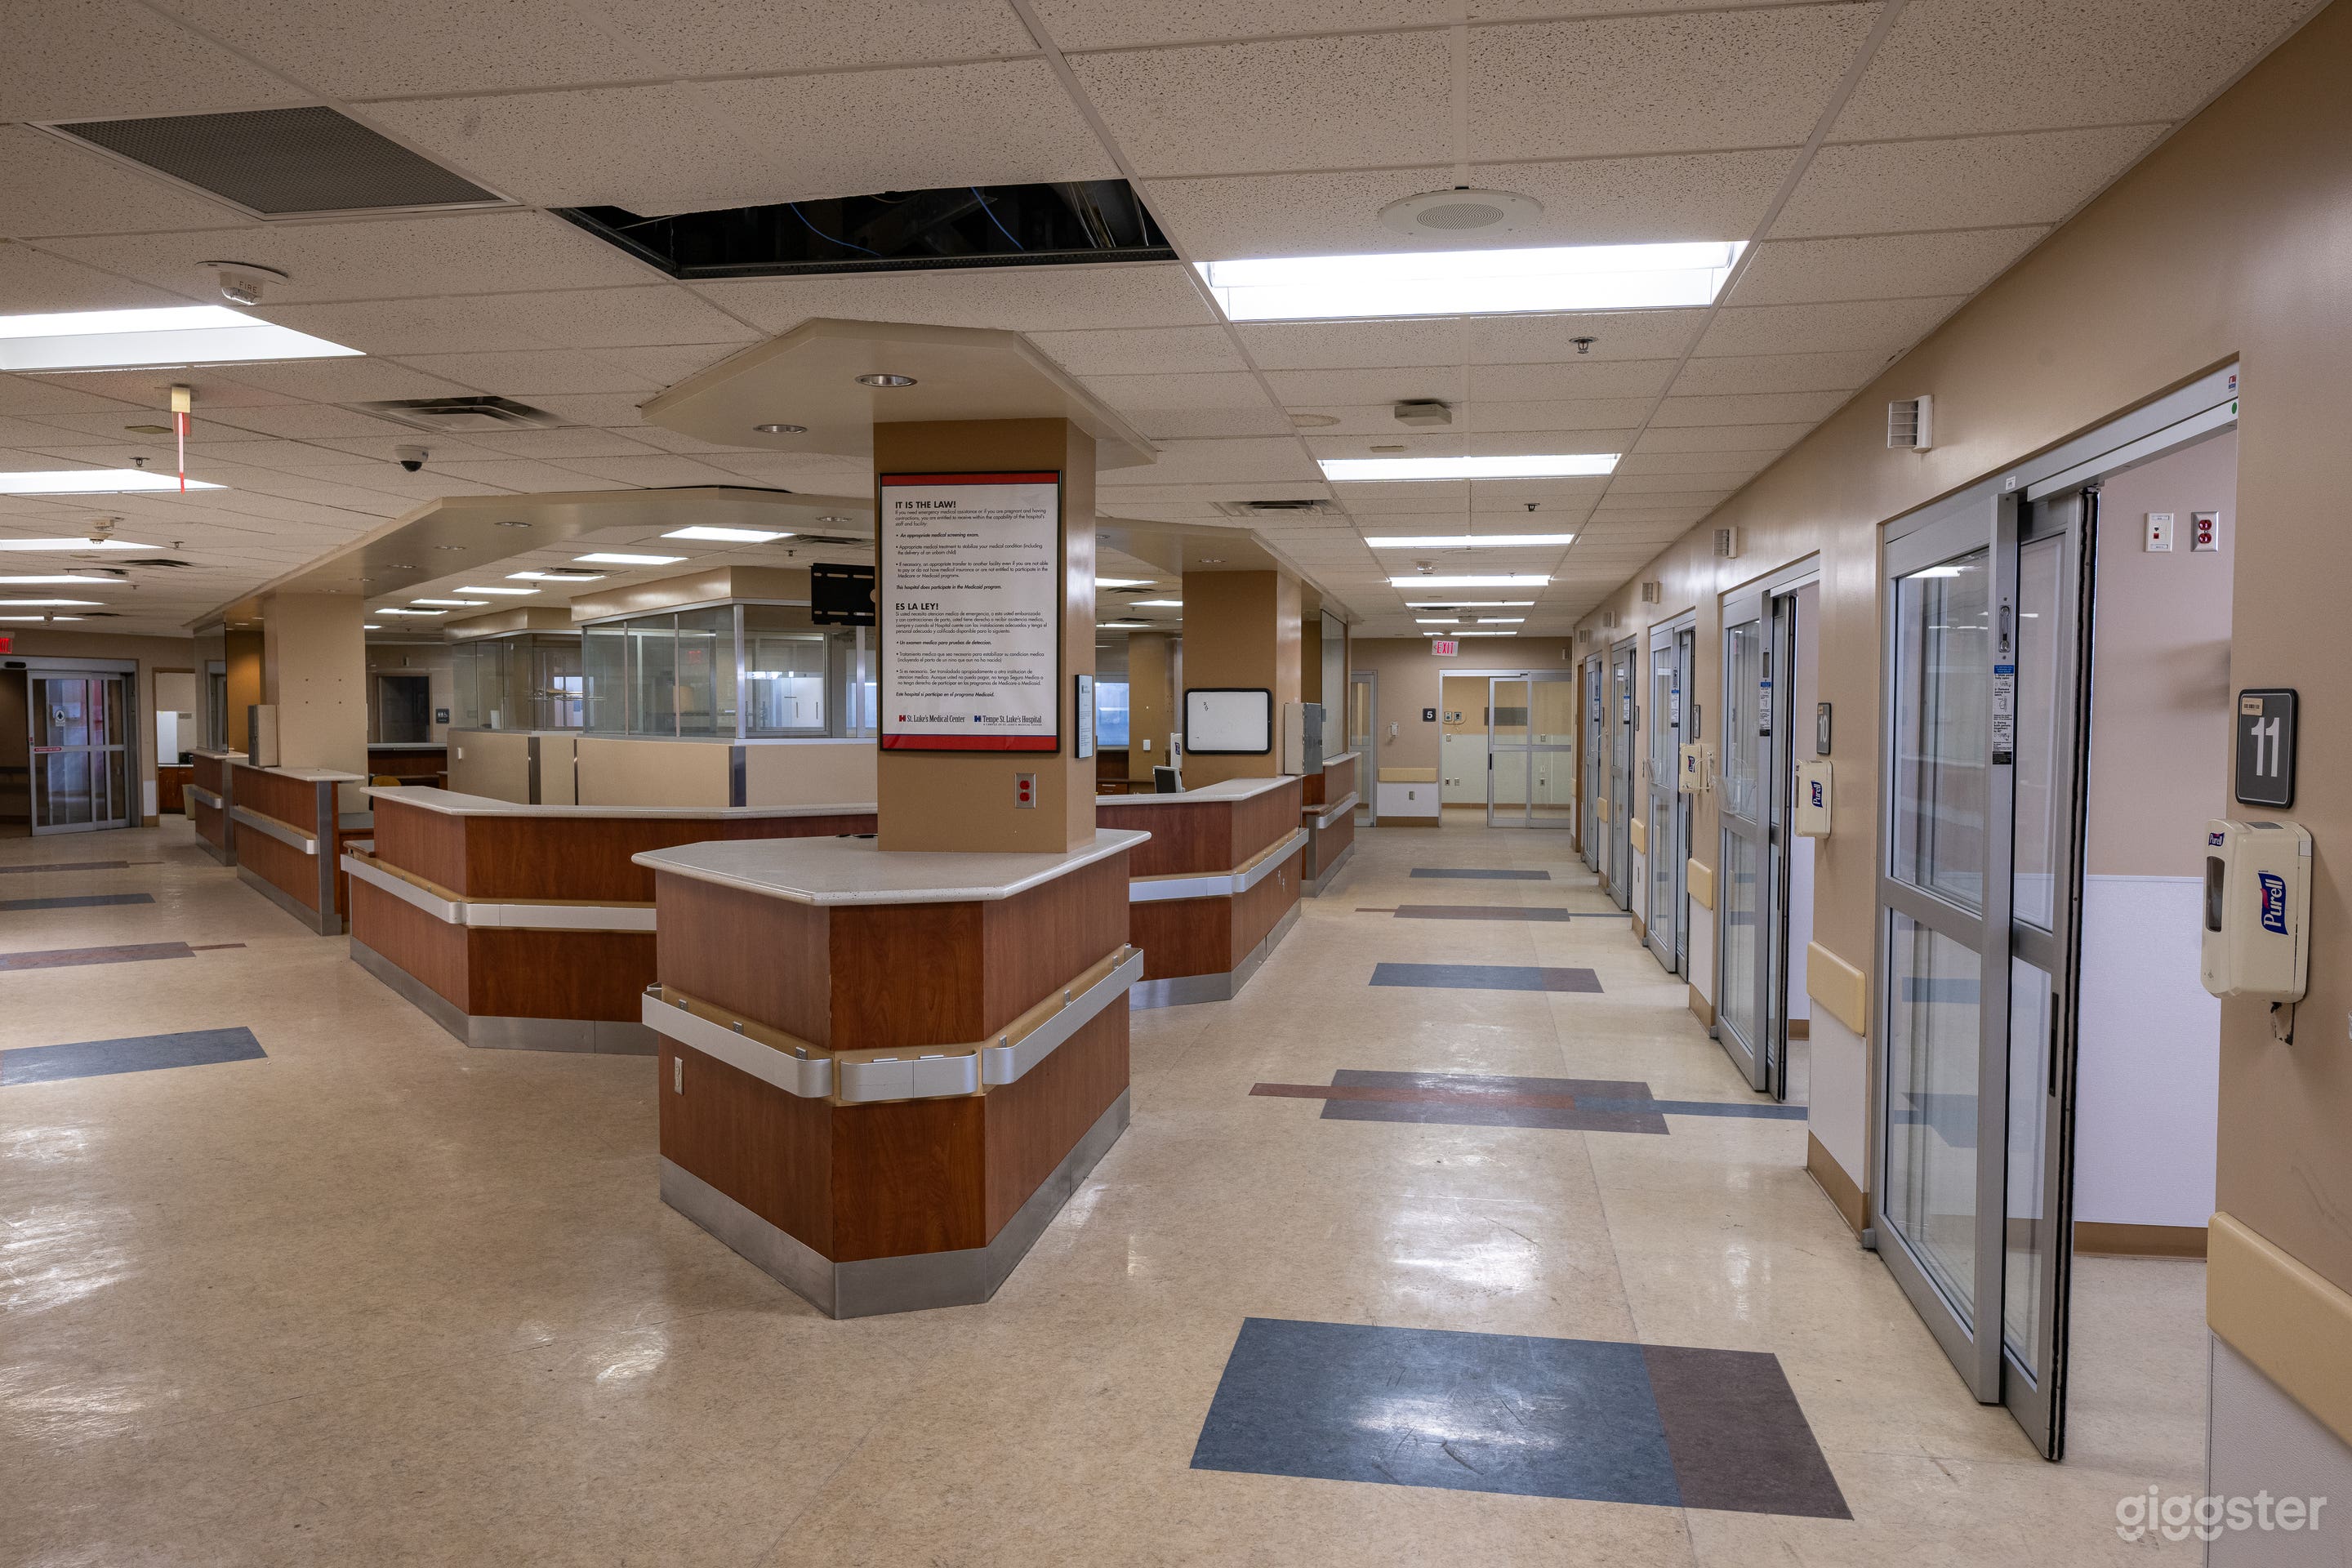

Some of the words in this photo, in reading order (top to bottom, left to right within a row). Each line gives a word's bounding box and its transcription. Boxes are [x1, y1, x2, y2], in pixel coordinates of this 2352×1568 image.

[239, 281, 257, 293] FIRE
[1437, 642, 1454, 654] EXIT
[982, 715, 999, 724] Tempe
[1022, 715, 1041, 724] Hospital
[1819, 715, 1828, 743] 10
[2251, 717, 2279, 777] 11
[2210, 833, 2223, 845] Purell
[2264, 879, 2282, 927] Purell
